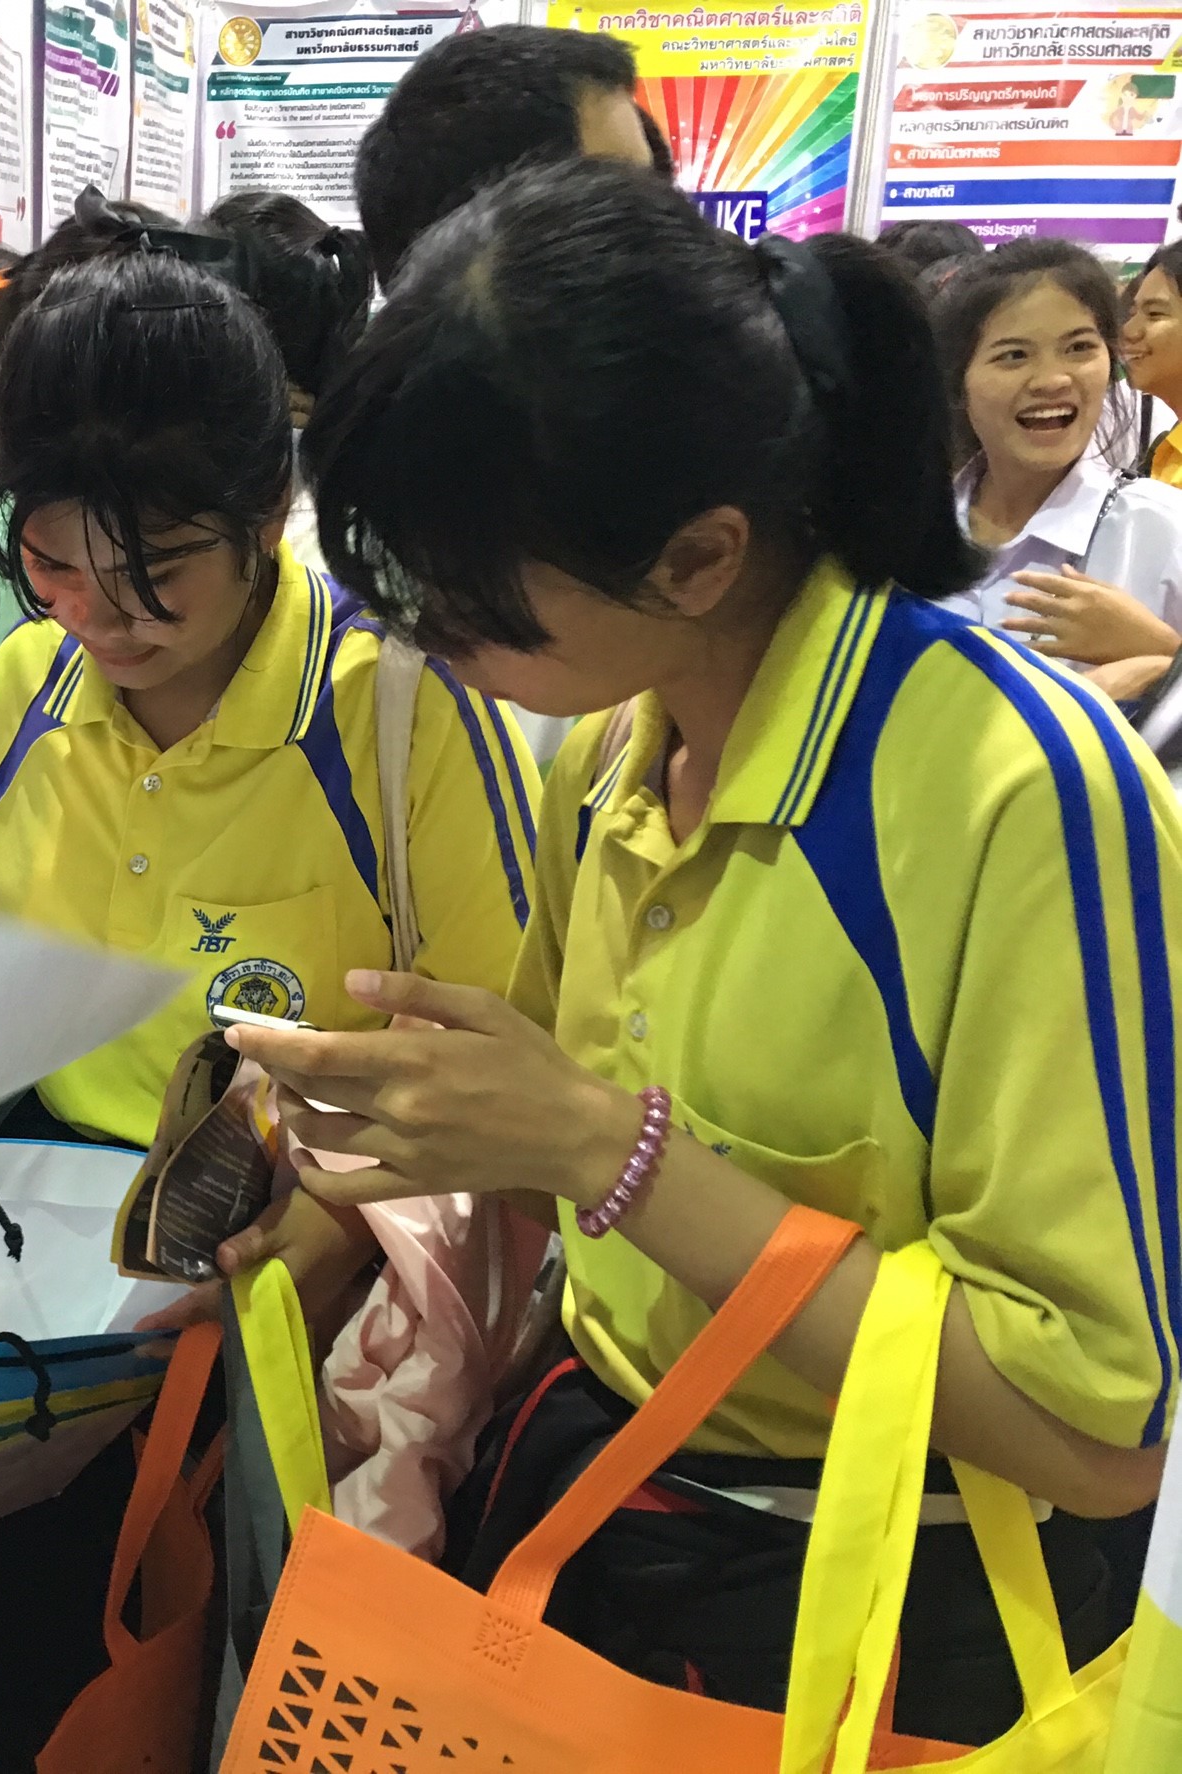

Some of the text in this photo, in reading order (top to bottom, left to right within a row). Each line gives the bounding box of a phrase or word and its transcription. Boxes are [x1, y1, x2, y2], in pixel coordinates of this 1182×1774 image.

[285, 24, 433, 39] สาขาวิชาคณิตศาสตร์และสถิติ
[296, 41, 419, 55] มหาวิทยาลัยธรรมศาสตร์
[907, 142, 1001, 160] สาขาคณิตศาสตร์
[903, 184, 955, 199] สาขาสถิติ
[190, 935, 237, 953] FBT
